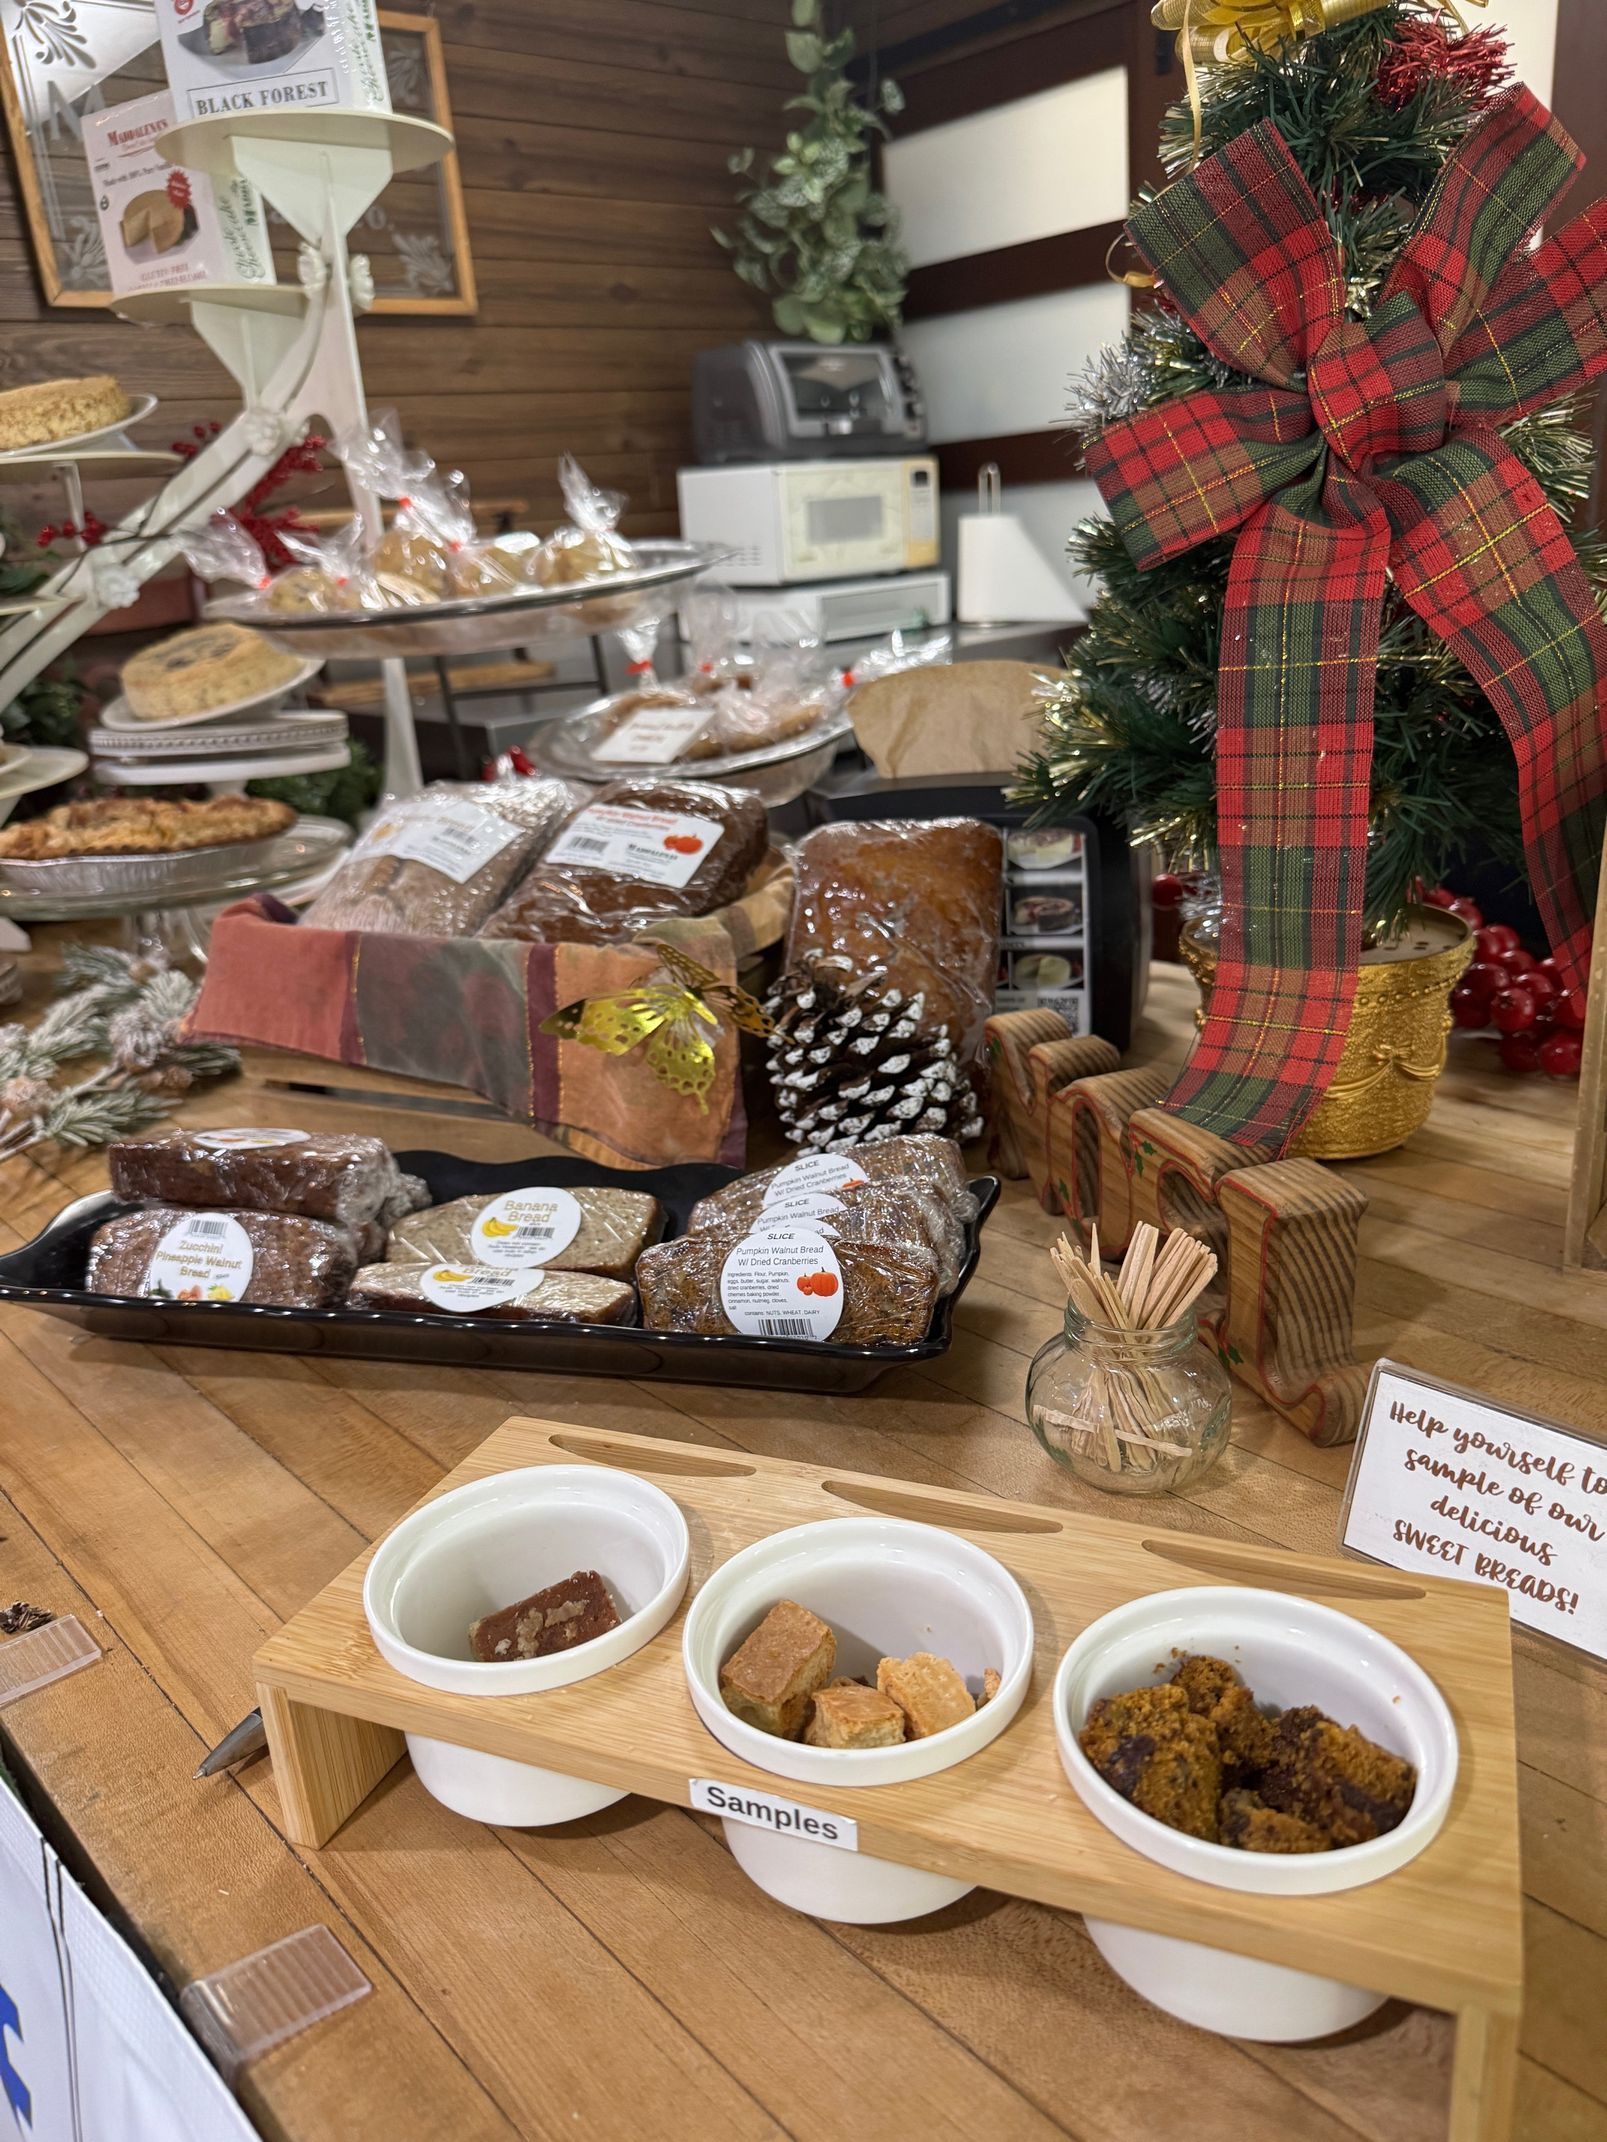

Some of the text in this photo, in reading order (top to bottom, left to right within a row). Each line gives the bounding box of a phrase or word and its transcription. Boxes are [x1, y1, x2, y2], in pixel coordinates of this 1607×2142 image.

[196, 81, 328, 115] BLACK FOREST
[795, 1159, 820, 1172] SLICE
[771, 1163, 850, 1190] Pumpkin Walnut Bread
[786, 1184, 806, 1195] Dried
[806, 1173, 848, 1189] Cranberries
[504, 1200, 559, 1212] Banana
[784, 1198, 810, 1208] SLICE
[507, 1211, 553, 1223] Bread
[757, 1206, 840, 1225] Pumpkin Walnut Bread
[179, 1240, 224, 1254] Zucchini
[736, 1245, 824, 1256] Pumpkin Walnut Bread
[156, 1250, 243, 1270] Pineapple Walnut
[738, 1257, 819, 1266] W/ Dried Cranberries
[179, 1265, 211, 1279] Bread
[1390, 1401, 1448, 1438] Help
[1453, 1427, 1575, 1486] yourself
[1404, 1448, 1605, 1541] sample of our
[1431, 1495, 1558, 1566] delicious
[1392, 1519, 1579, 1615] SWEET BREADS!
[707, 1786, 838, 1840] Samples
